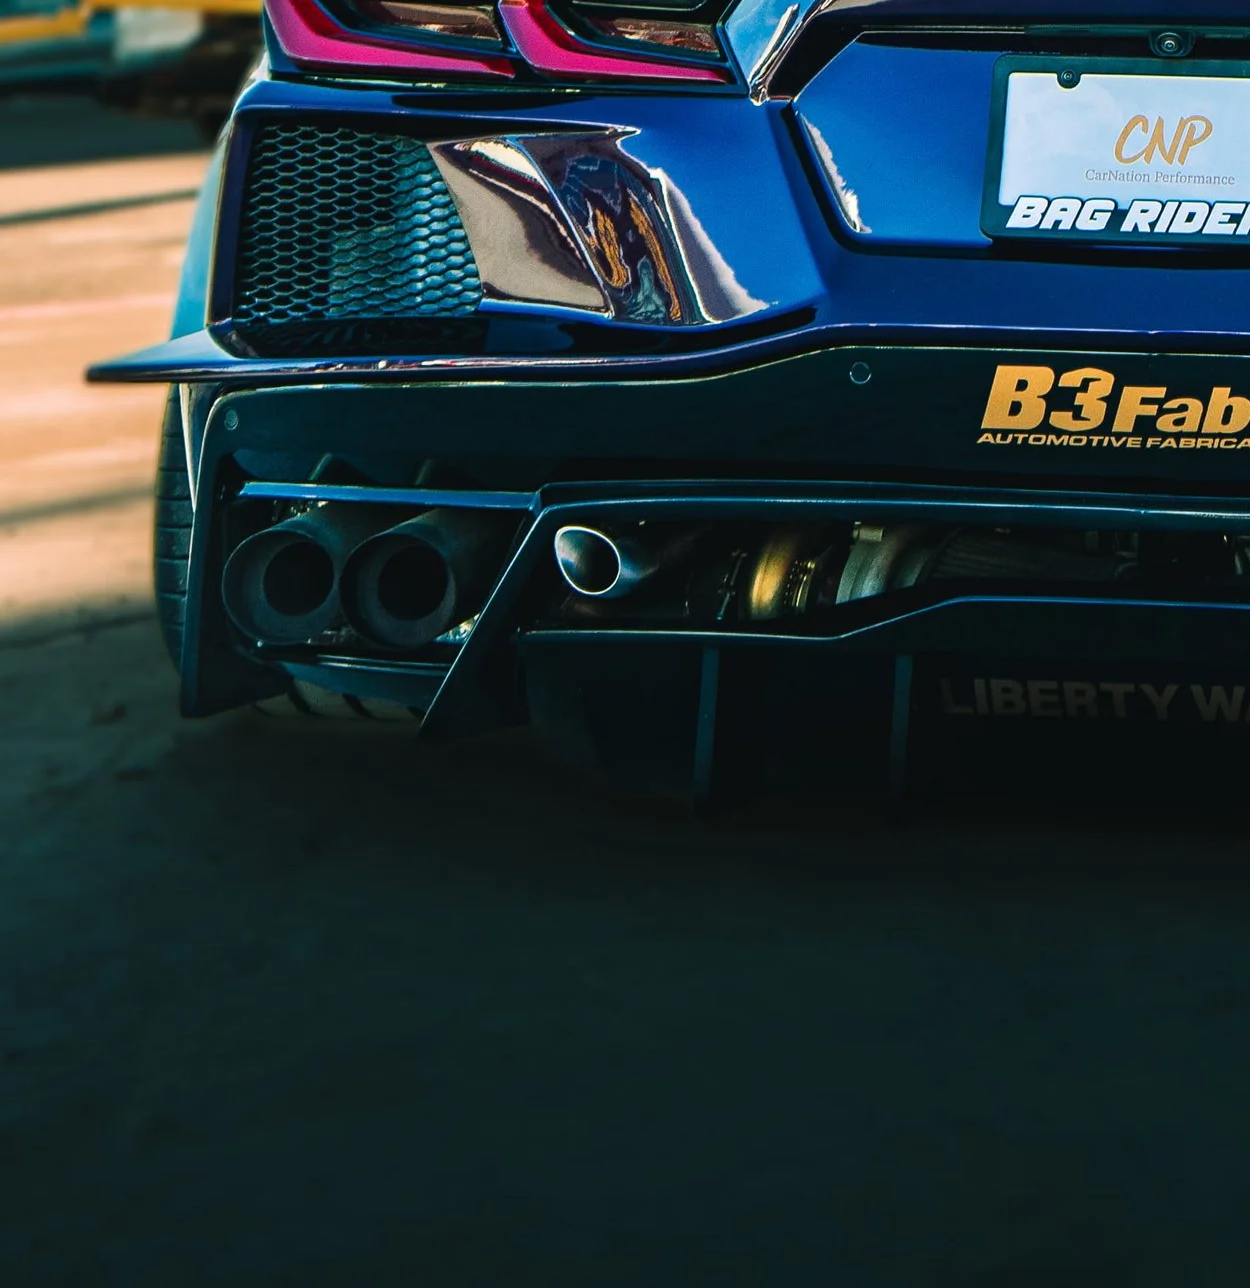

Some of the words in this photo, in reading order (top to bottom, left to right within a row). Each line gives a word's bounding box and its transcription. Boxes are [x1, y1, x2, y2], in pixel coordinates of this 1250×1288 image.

[1114, 114, 1213, 166] CNP
[1085, 168, 1151, 184] CarNation
[1154, 171, 1235, 187] Performance
[1006, 196, 1115, 232] BAG
[976, 432, 1142, 448] AUTOMOTIVE
[940, 677, 1180, 719] LIBERTY
